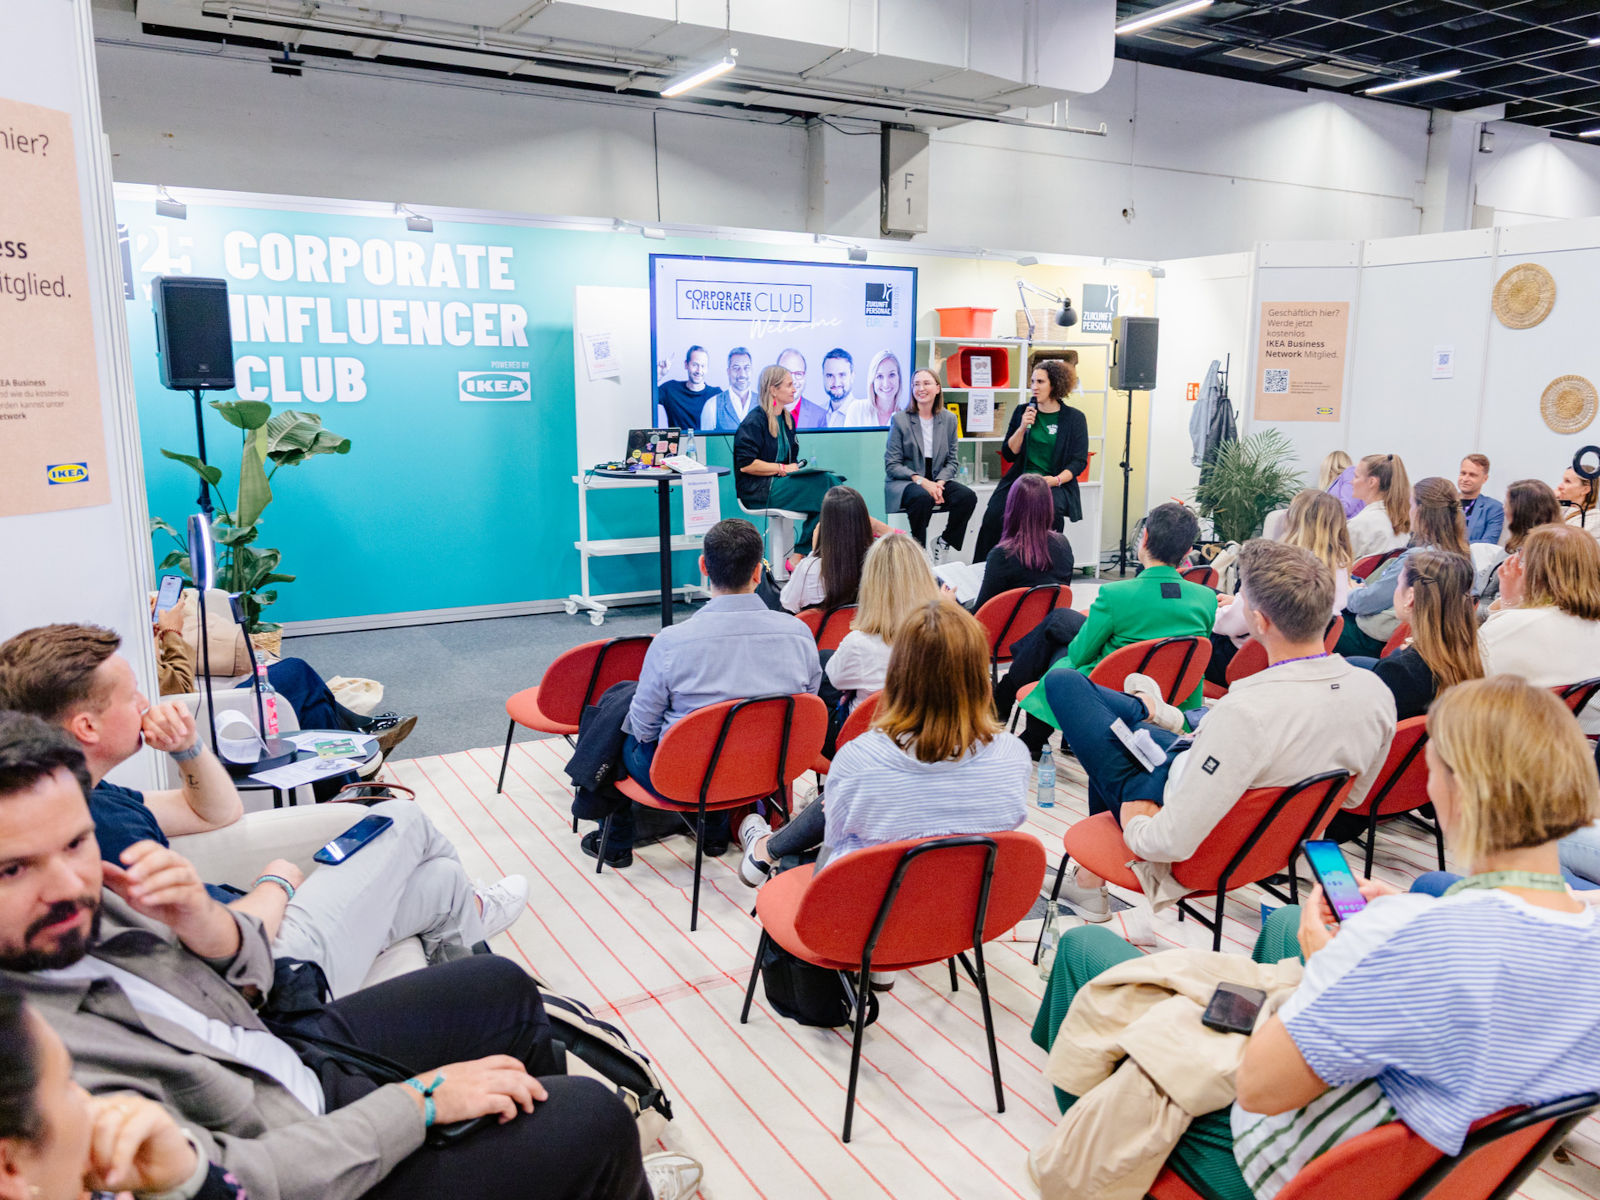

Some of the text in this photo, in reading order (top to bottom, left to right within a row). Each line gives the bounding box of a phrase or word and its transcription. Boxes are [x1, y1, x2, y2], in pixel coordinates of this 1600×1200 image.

[904, 172, 914, 190] F
[223, 230, 516, 291] CORPORATE
[685, 289, 752, 302] CORPORATE
[691, 300, 752, 311] INFLUENCER
[755, 292, 804, 313] CLUB
[1083, 311, 1113, 321] ZUKUNFT
[1268, 308, 1340, 317] Geschäftlich hier?
[228, 294, 530, 348] INFLUENCER
[749, 313, 842, 340] Welcome
[1082, 321, 1112, 331] PERSONA
[1267, 319, 1313, 329] Werde jetzt
[1266, 329, 1306, 337] kostenlos
[1266, 340, 1325, 348] IKEA Business
[1265, 350, 1338, 360] Network Mitglied.
[490, 361, 529, 369] POWERED BY
[12, 379, 46, 387] Business
[235, 355, 368, 403] CLUB
[466, 380, 525, 392] IKEA
[51, 468, 85, 479] IKEA
